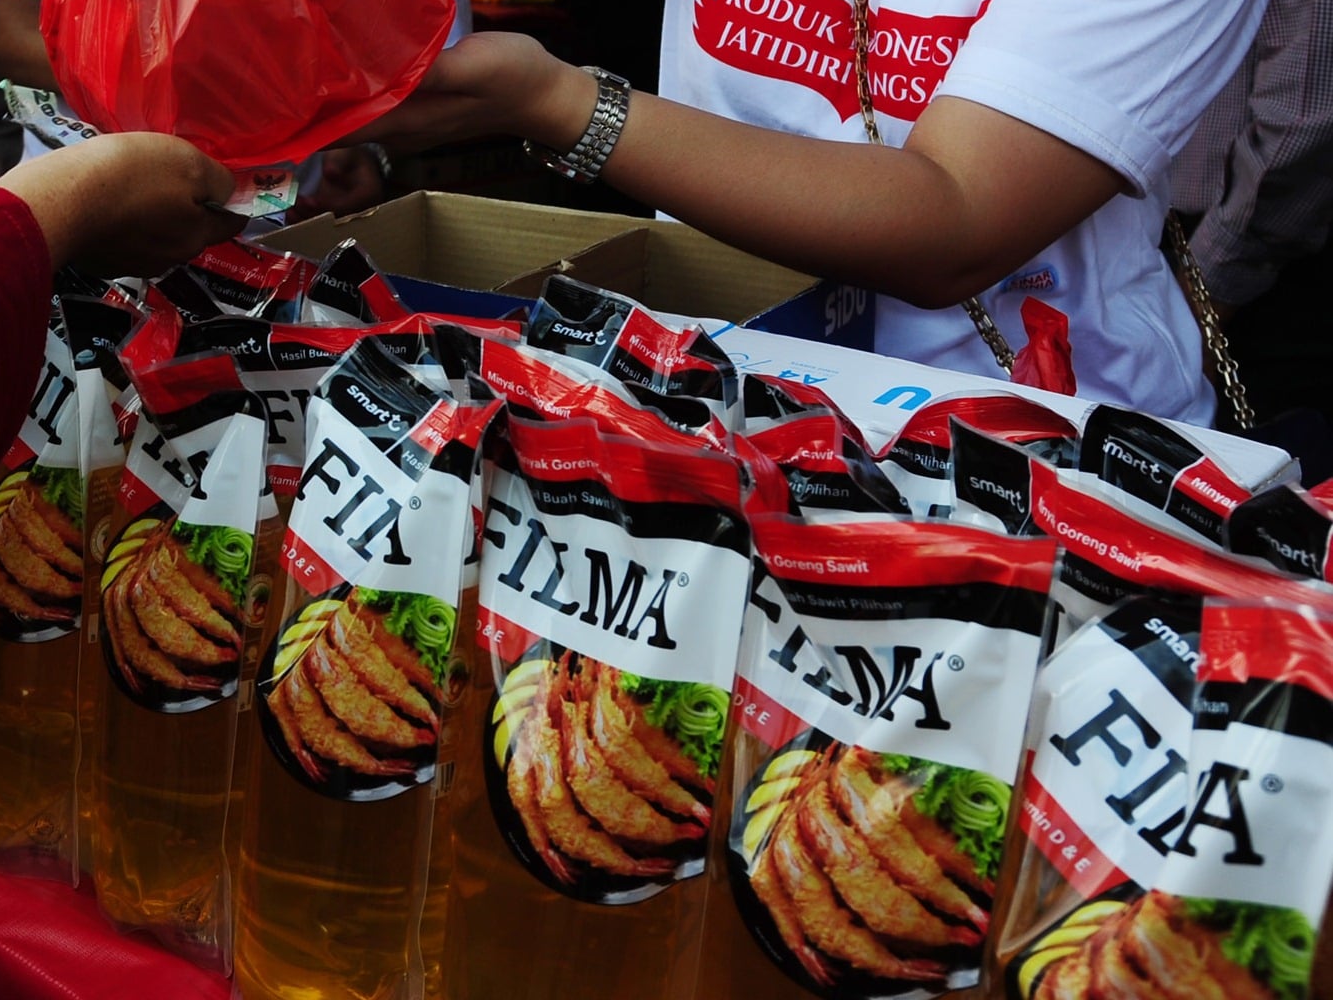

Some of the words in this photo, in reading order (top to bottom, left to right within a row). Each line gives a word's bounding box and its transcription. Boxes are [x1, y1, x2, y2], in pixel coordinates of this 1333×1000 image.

[716, 20, 852, 85] JATIDIRI
[280, 349, 307, 362] Hasil
[629, 334, 663, 363] Minyak
[616, 359, 641, 383] Hasil
[641, 376, 668, 395] Buah
[543, 492, 578, 504] Buah
[803, 483, 850, 497] Pilihan
[1057, 521, 1108, 555] Goreng
[1108, 545, 1143, 572] Sawit
[774, 555, 824, 574] Goreng
[826, 560, 870, 573] Sawit
